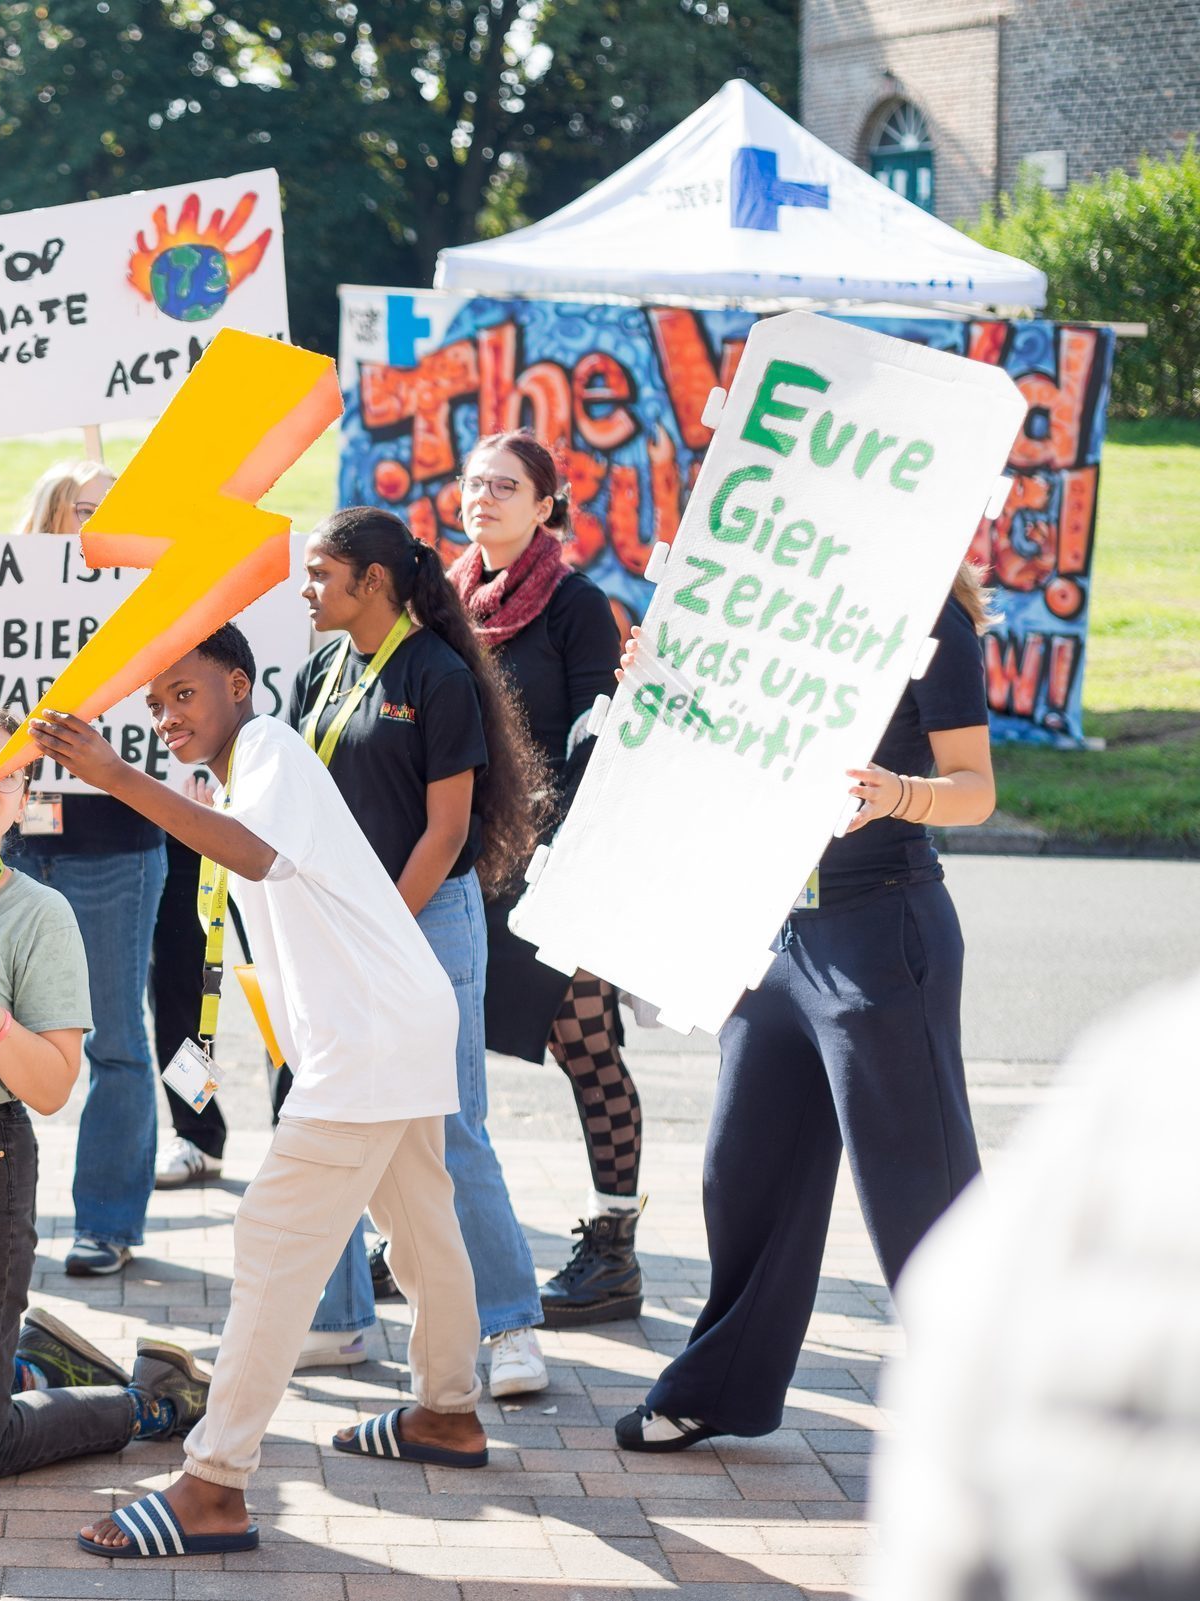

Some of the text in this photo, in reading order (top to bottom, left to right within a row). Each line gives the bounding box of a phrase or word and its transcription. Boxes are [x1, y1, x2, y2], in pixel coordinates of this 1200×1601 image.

[105, 349, 180, 398] ACT
[740, 359, 935, 493] Eure
[708, 464, 850, 579] Gier
[657, 621, 860, 730] was uns
